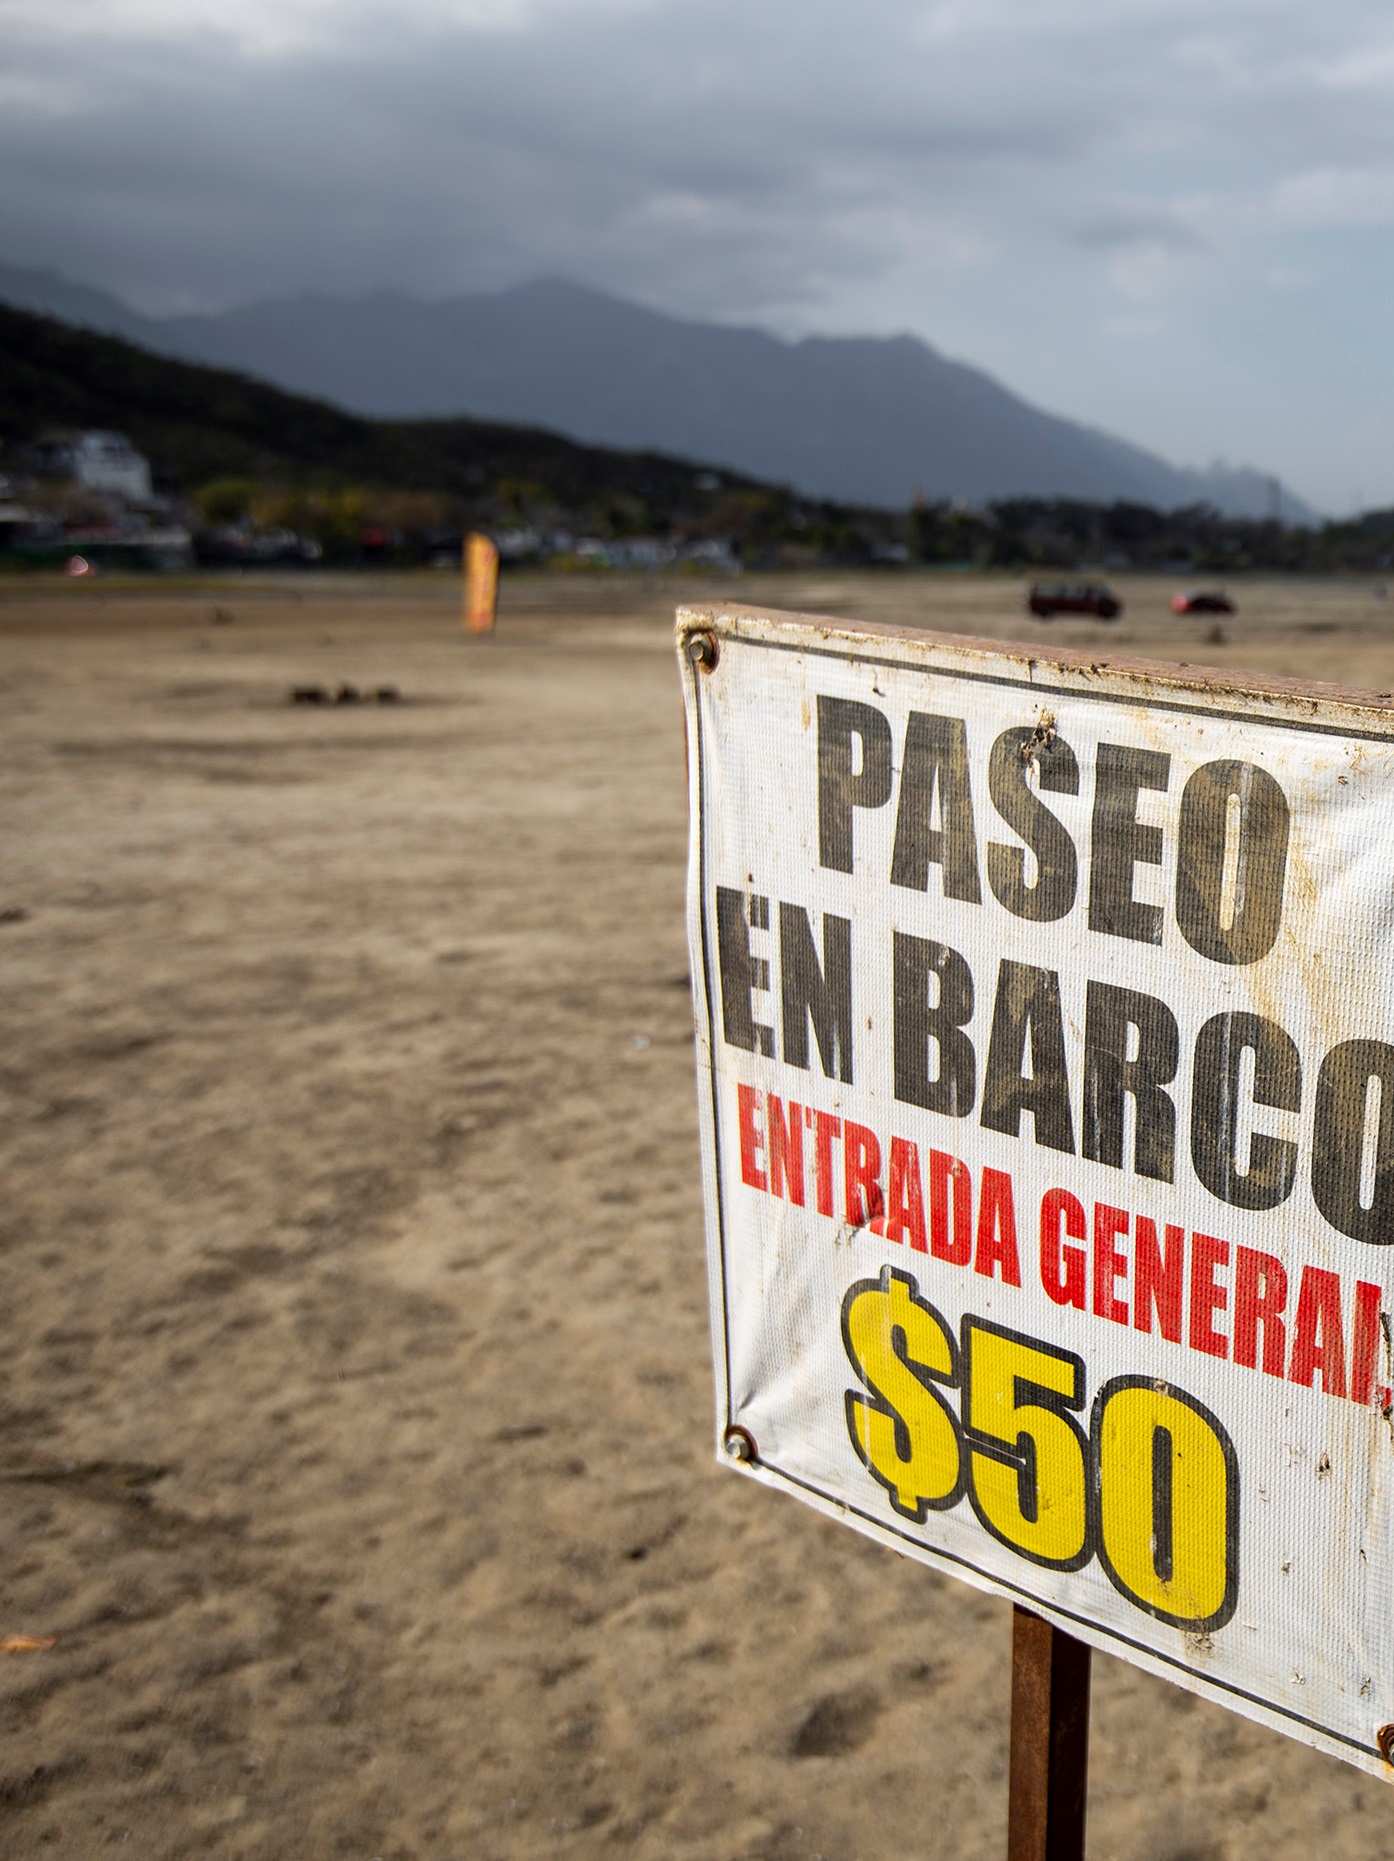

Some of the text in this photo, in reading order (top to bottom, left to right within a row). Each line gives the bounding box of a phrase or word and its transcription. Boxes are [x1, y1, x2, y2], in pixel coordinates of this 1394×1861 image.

[816, 694, 1290, 966] PASEO
[716, 886, 854, 1084] EN
[737, 1083, 1392, 1409] ENTRADA GENERAL
[840, 1264, 1240, 1634] $50
